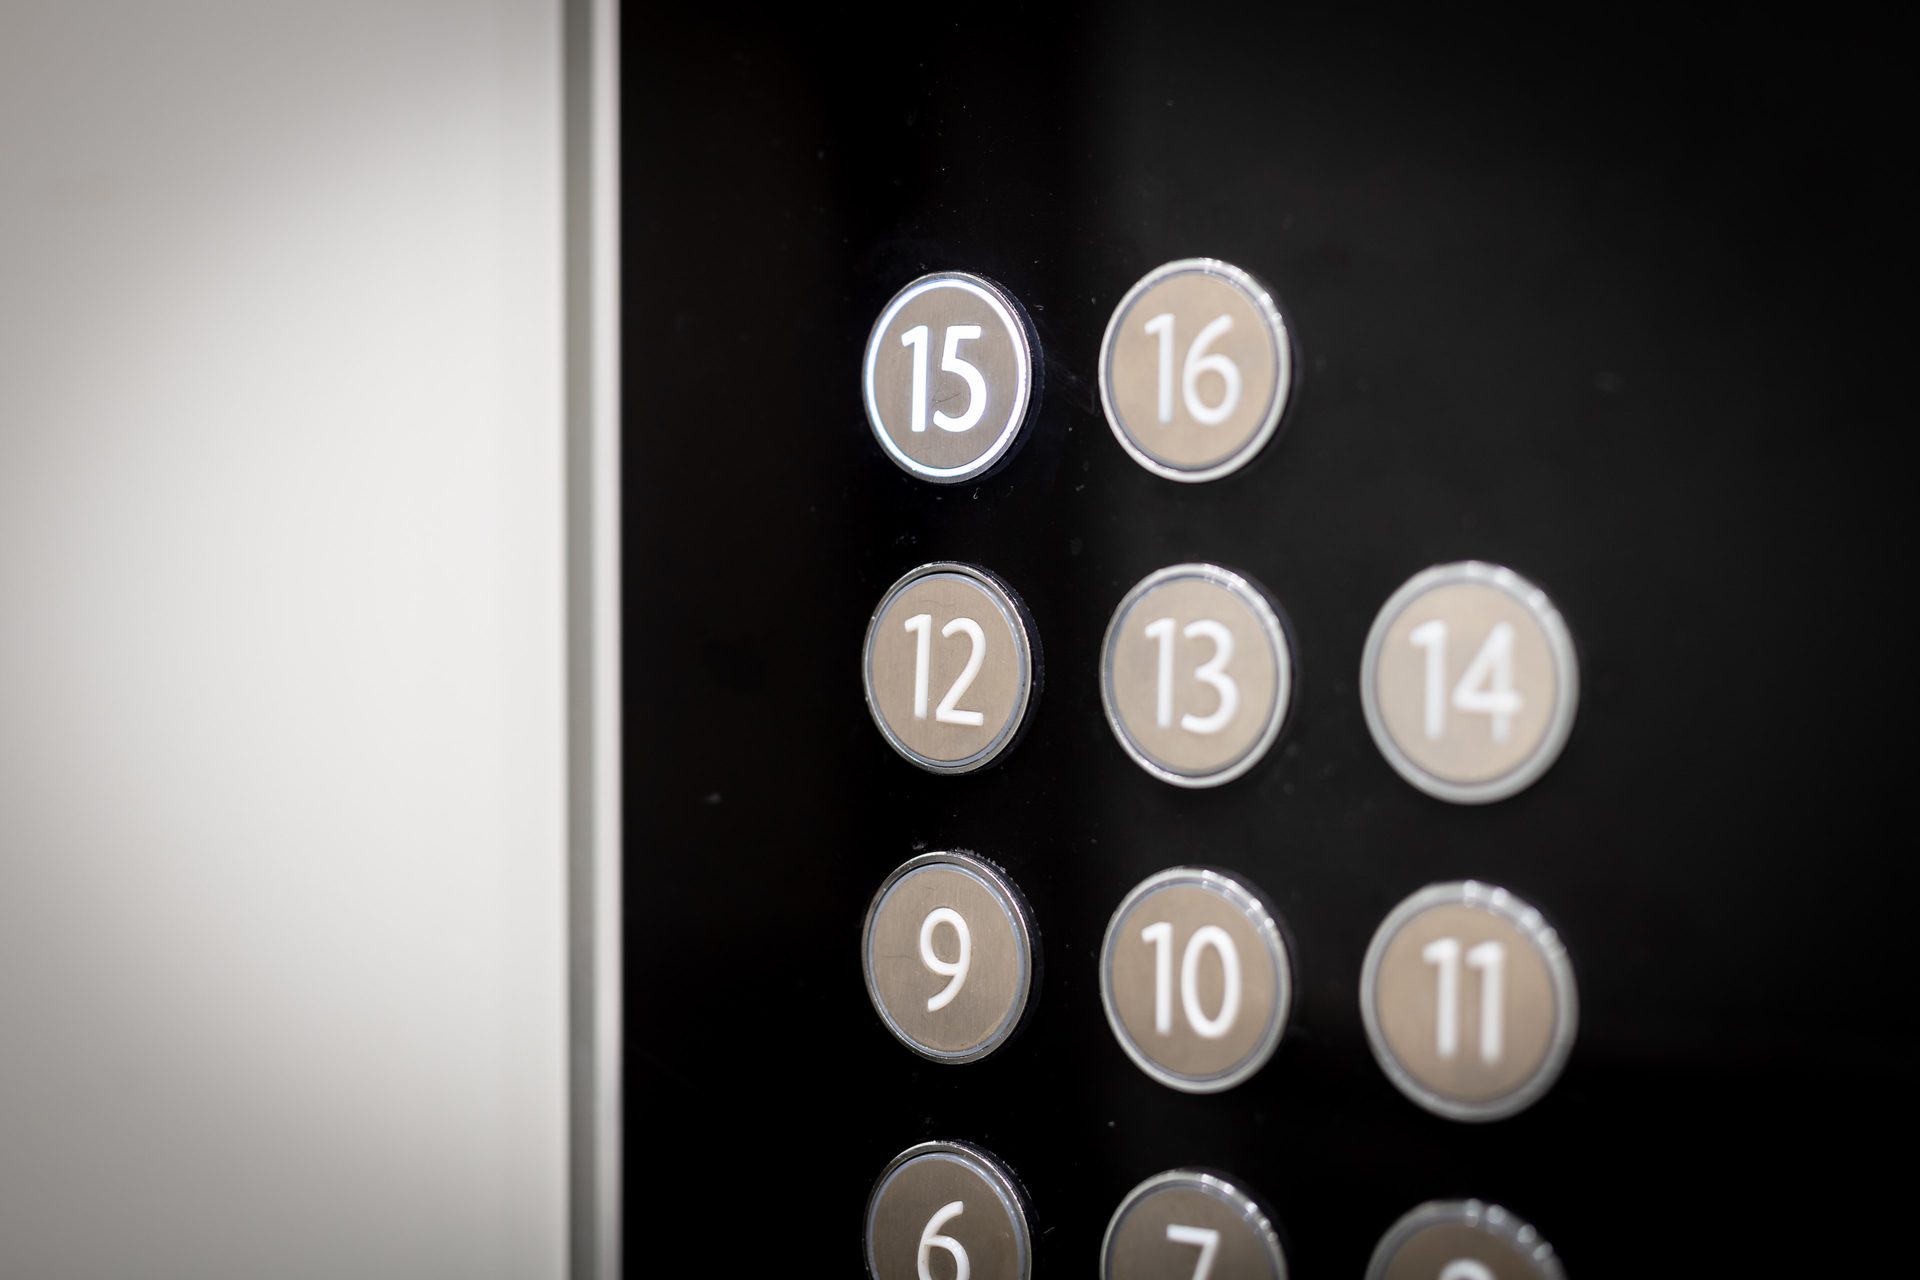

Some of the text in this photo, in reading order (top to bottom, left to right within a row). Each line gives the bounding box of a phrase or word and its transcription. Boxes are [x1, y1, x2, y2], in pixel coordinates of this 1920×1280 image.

[901, 326, 987, 432] 15
[1145, 314, 1240, 424] 16
[905, 614, 986, 725] 12
[1145, 618, 1238, 732] 13
[1411, 620, 1521, 740] 14
[920, 908, 971, 1011] 9
[1142, 923, 1240, 1036] 10
[1424, 939, 1504, 1060] 11
[918, 1201, 970, 1280] 6
